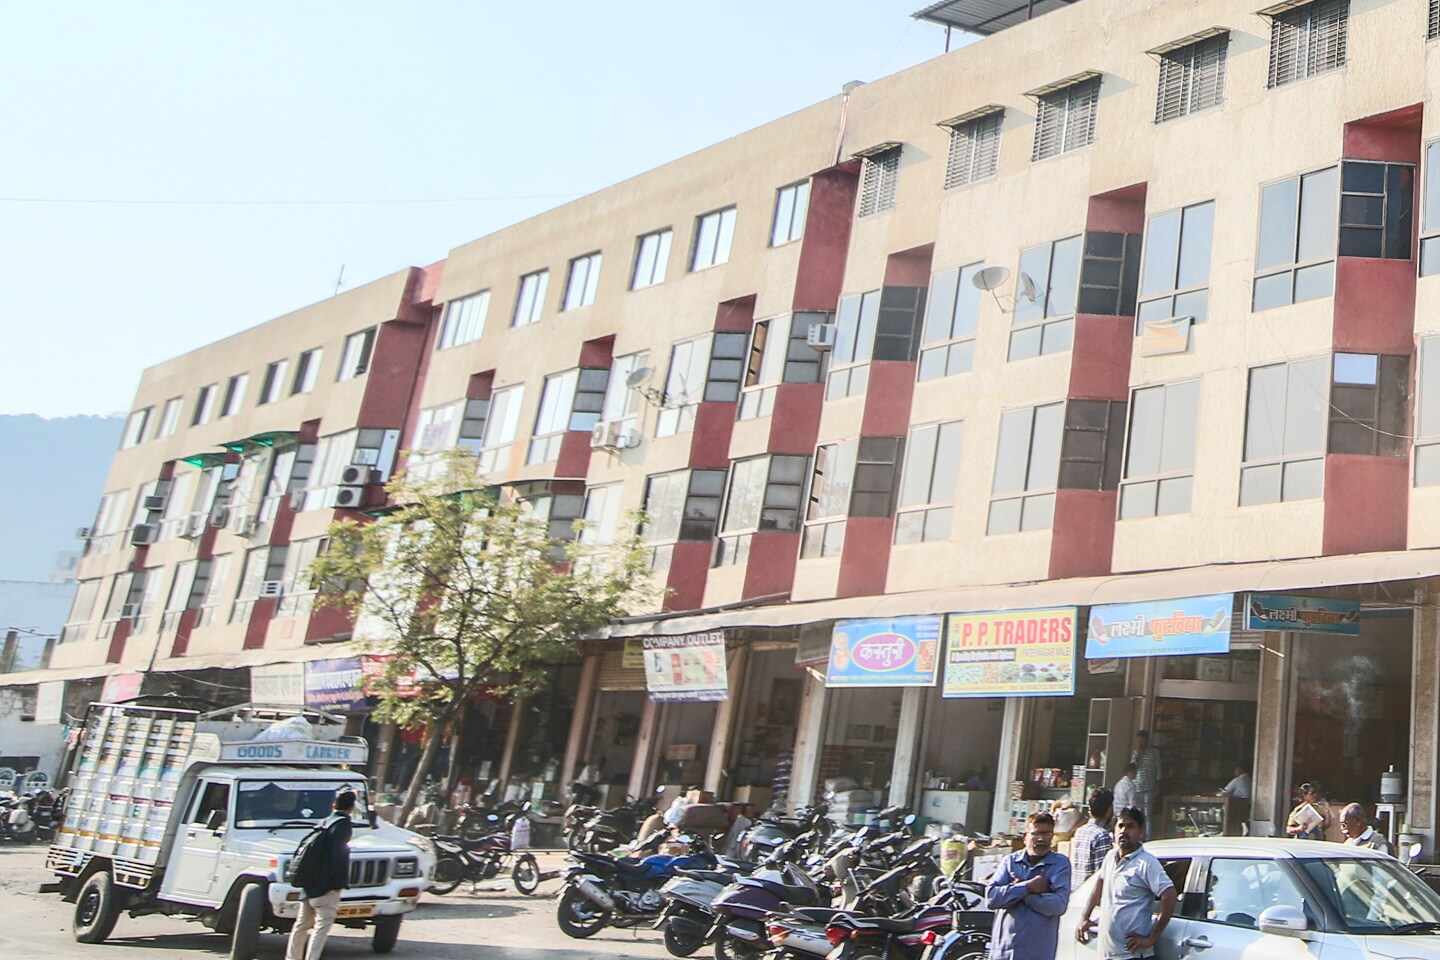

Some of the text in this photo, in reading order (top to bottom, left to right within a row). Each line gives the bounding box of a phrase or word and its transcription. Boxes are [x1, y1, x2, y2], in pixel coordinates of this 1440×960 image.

[643, 632, 722, 649] COMPANY OUTLET
[961, 622, 973, 647] P.
[977, 621, 988, 646] P.
[993, 617, 1072, 646] TRADERS
[237, 744, 352, 759] GOODS CARRIER
